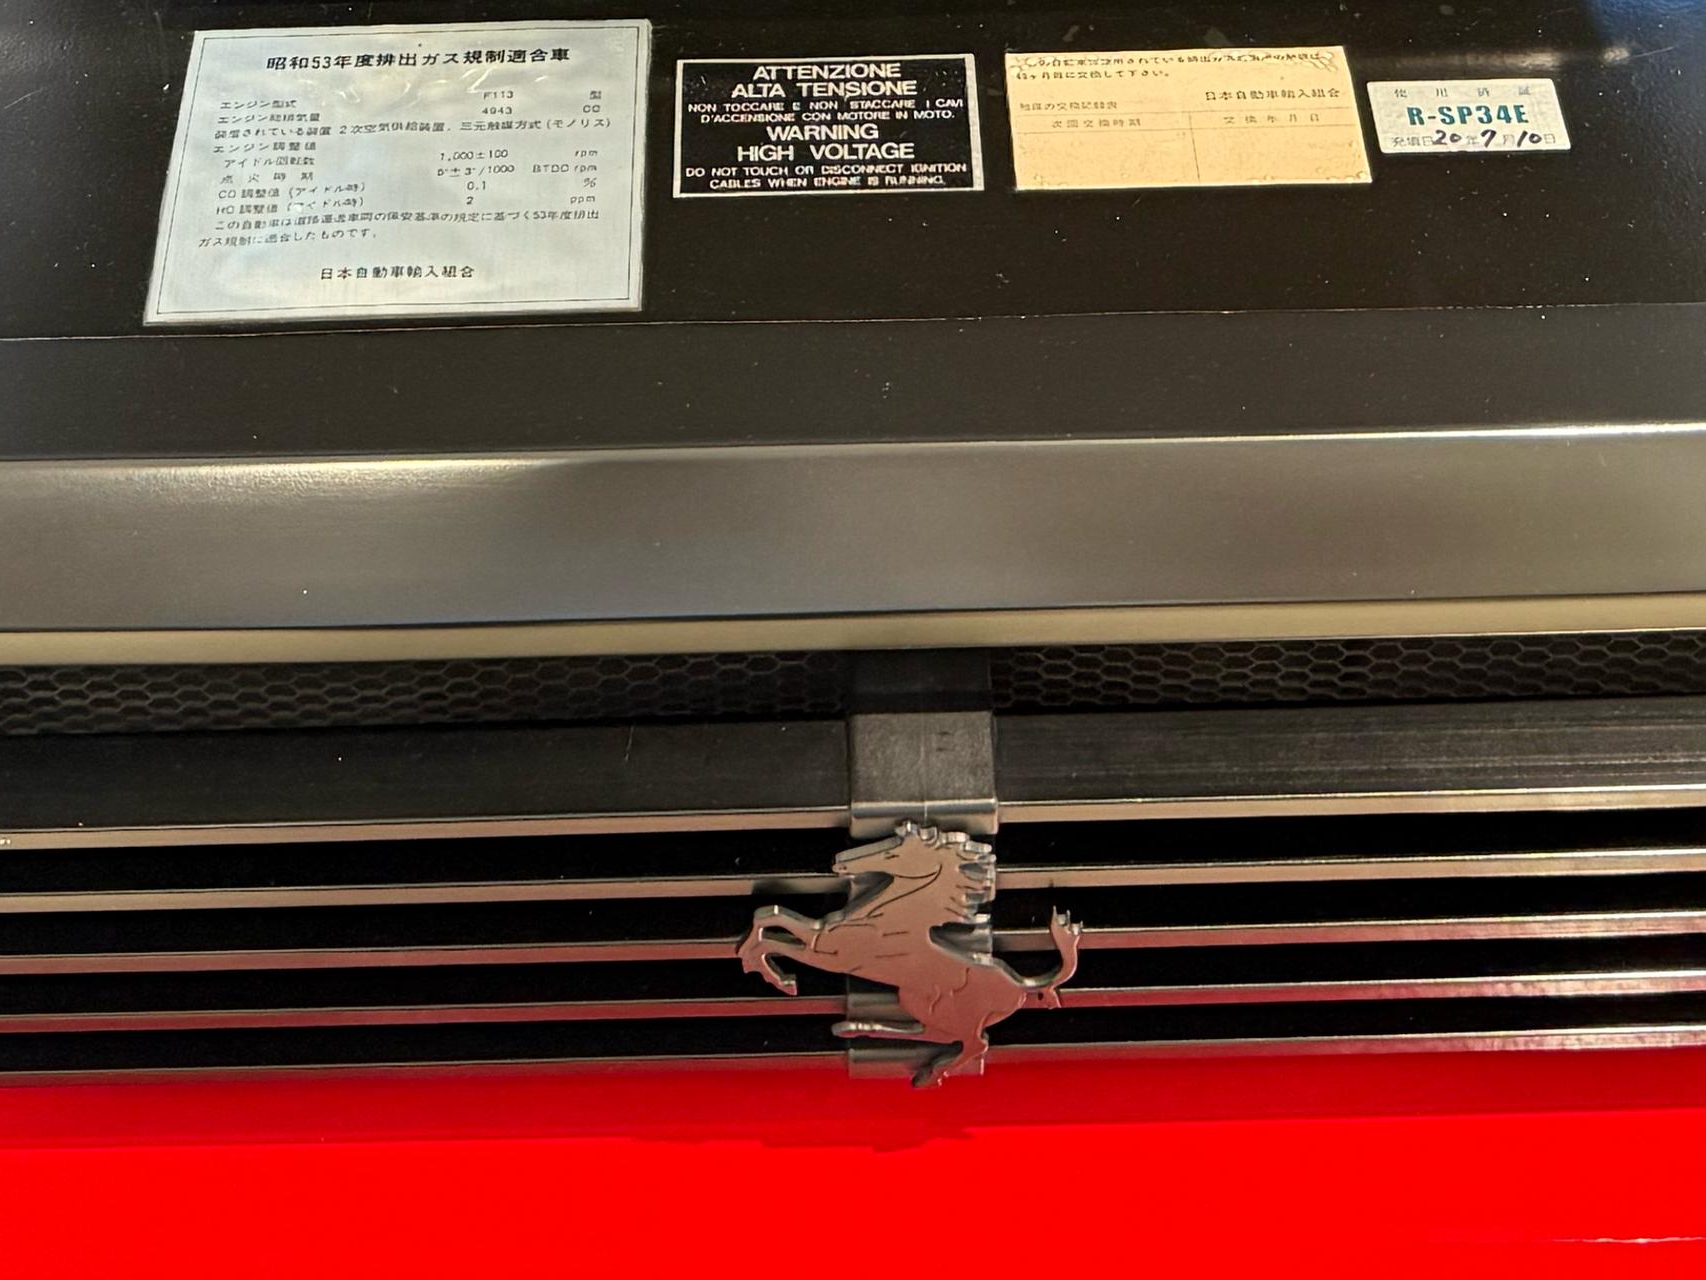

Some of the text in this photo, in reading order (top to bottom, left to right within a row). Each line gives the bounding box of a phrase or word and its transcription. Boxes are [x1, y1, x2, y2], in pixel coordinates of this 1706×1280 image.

[752, 62, 901, 81] ATTENZIONE
[731, 80, 918, 98] ALTA TENSIONE
[688, 103, 717, 113] NON
[723, 102, 785, 112] TOCCARE
[792, 101, 801, 111] E
[809, 100, 838, 110] NON
[849, 99, 916, 109] STACCARE
[935, 98, 963, 108] CAVI
[700, 109, 955, 124] D'ACCENSIONE CON MOTORE IN MOTO.
[1406, 104, 1530, 126] R-SP34E
[766, 123, 879, 141] WARNING
[737, 142, 915, 161] HIGH VOLTAGE
[686, 162, 967, 177] DO NOT TOUCH OR DISCONNECT IGNITION
[709, 178, 762, 190] CABLES
[767, 177, 807, 188] WHEN
